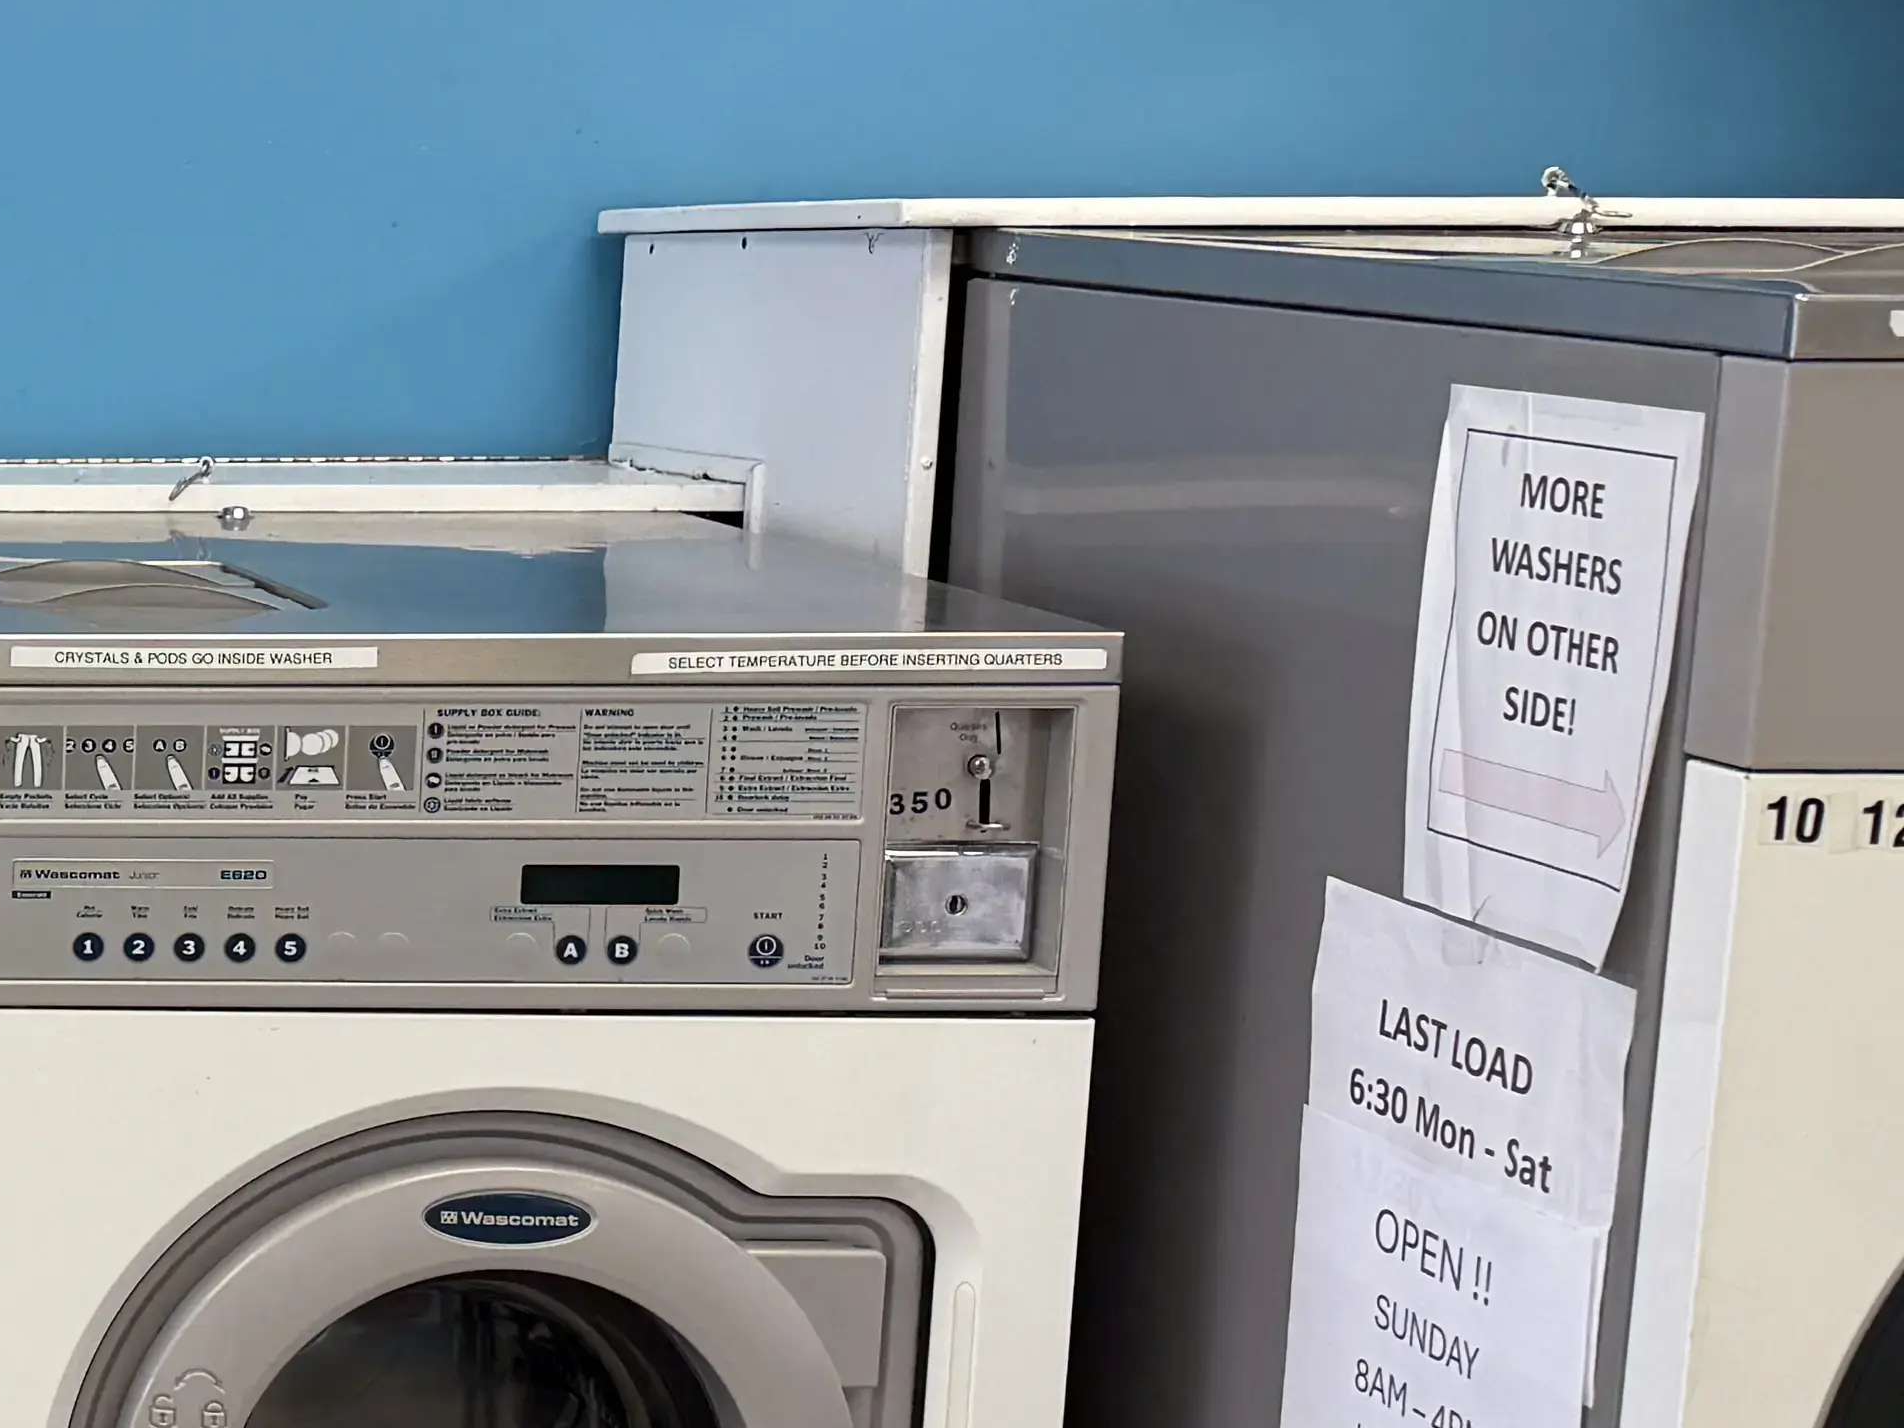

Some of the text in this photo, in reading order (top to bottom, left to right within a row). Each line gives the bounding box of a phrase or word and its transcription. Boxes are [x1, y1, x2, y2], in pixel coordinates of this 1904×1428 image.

[1520, 473, 1606, 519] MORE
[1491, 537, 1623, 595] WASHERS
[668, 652, 1063, 670] SELECT TEMPERATURE BEFORE INSERTING QUARTERS
[1477, 611, 1619, 674] ON OTHER
[1503, 686, 1576, 736] SIDE!
[890, 788, 952, 815] 350
[1767, 795, 1825, 844] 10
[1379, 999, 1533, 1095] LAST LOAD
[1350, 1068, 1408, 1124] 6:30
[1415, 1096, 1475, 1159] Mon
[1504, 1138, 1552, 1194] Sat
[461, 1210, 580, 1227] Wascomat
[1375, 1208, 1464, 1291] OPEN
[1374, 1294, 1480, 1380] SUNDAY
[1354, 1359, 1408, 1418] 8AM
